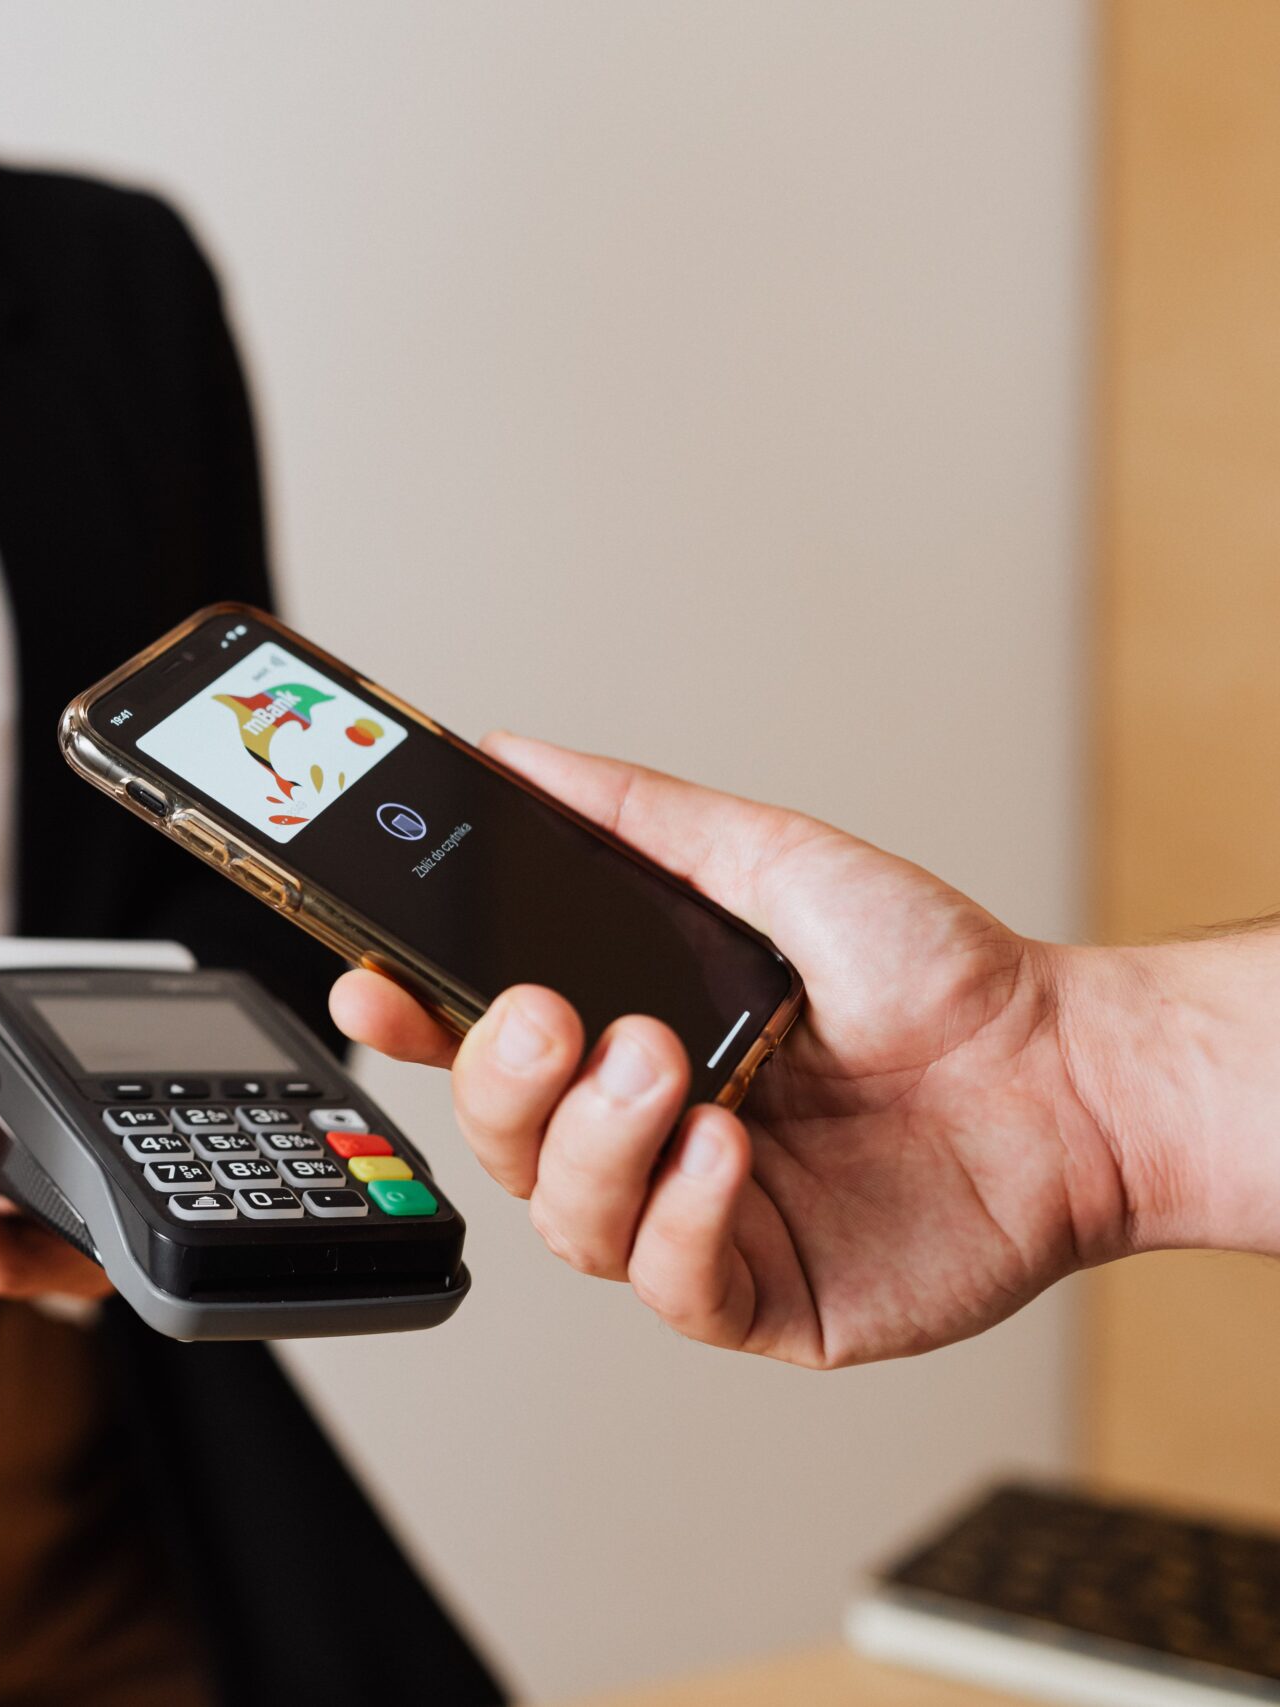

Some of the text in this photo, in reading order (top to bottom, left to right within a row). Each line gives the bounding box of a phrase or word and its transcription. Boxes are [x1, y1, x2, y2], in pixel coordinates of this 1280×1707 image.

[110, 709, 133, 726] 19:41
[242, 690, 301, 736] mBank
[411, 822, 472, 879] Zbliż do czytnika
